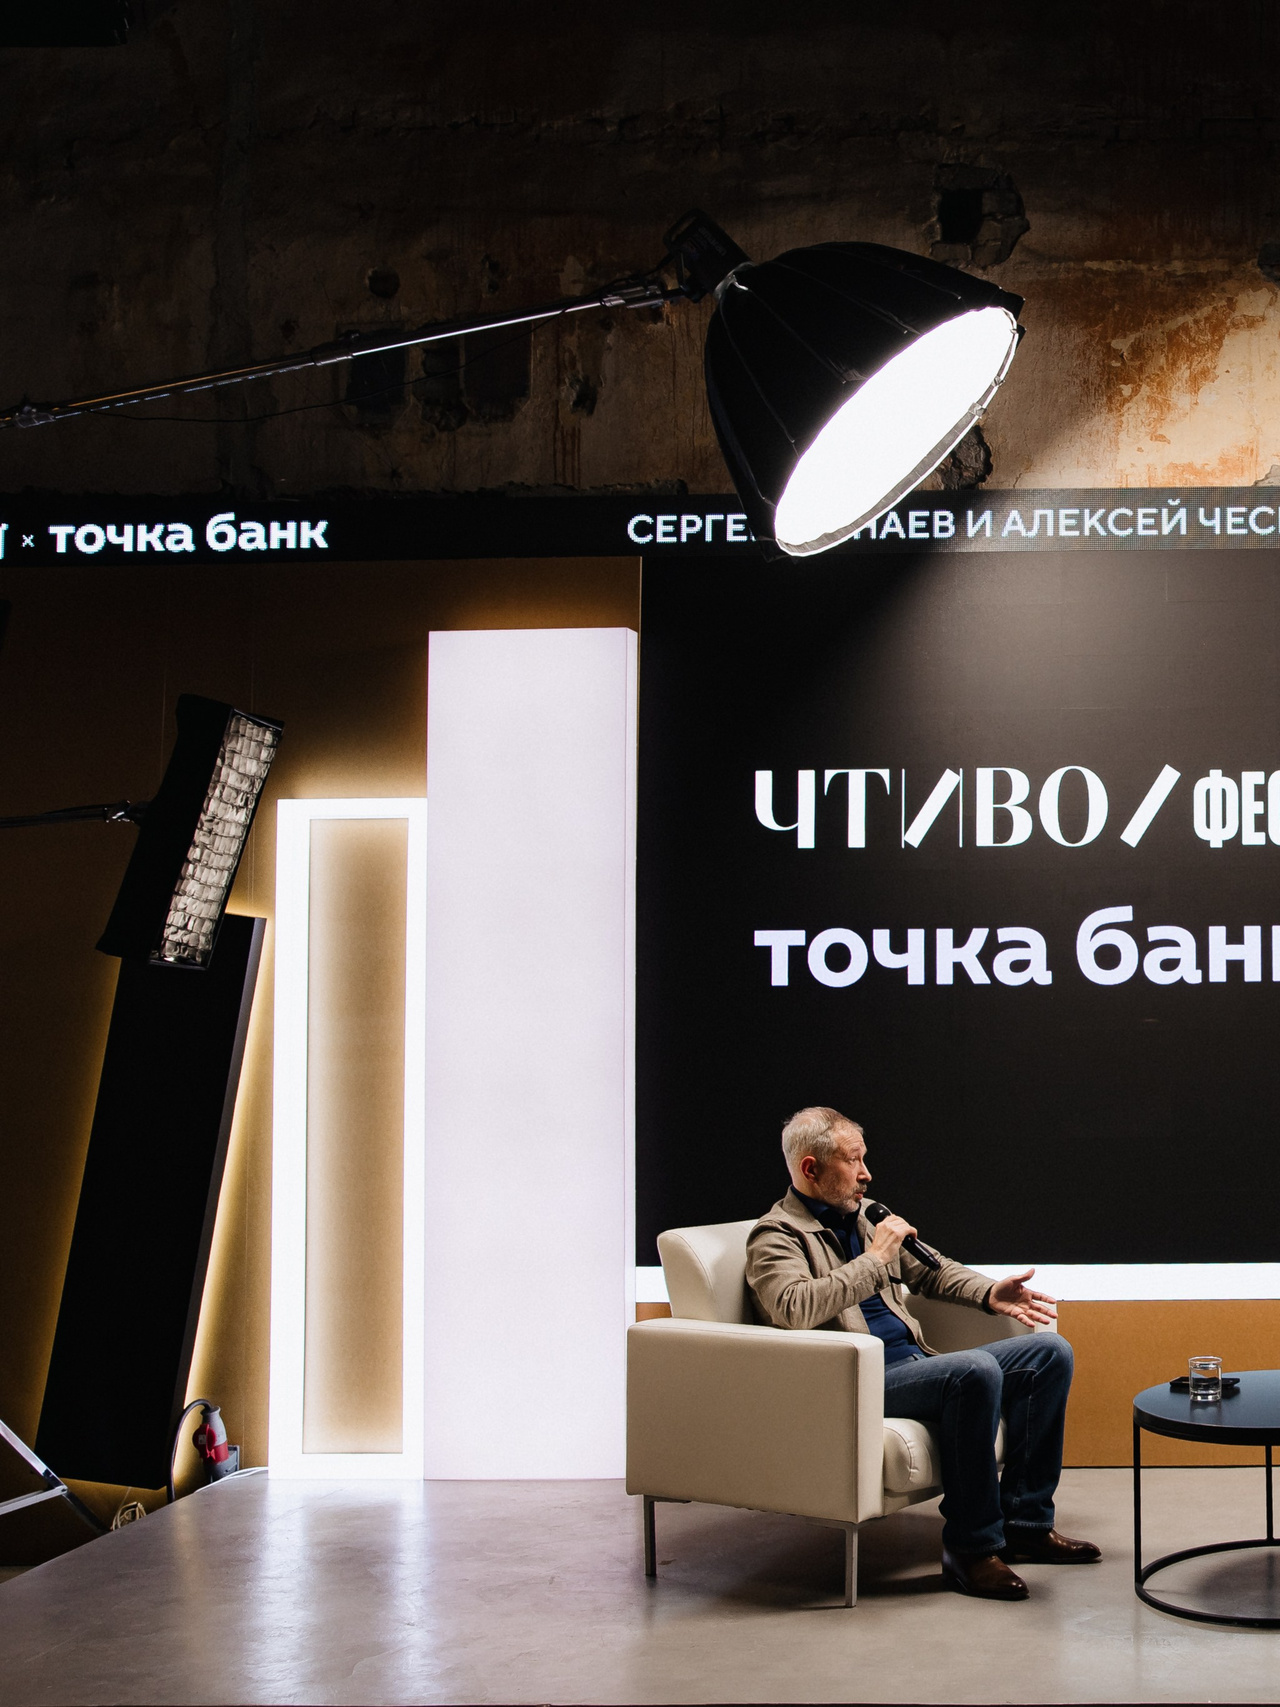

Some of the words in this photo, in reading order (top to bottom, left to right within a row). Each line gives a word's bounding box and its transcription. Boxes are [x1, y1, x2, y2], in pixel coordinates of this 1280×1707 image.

[48, 522, 195, 553] точка
[205, 511, 329, 551] банк
[627, 513, 756, 544] СЕРГЕ
[967, 509, 992, 538] И
[1001, 498, 1188, 539] АЛЕКСЕЙ
[754, 926, 1053, 988] точка
